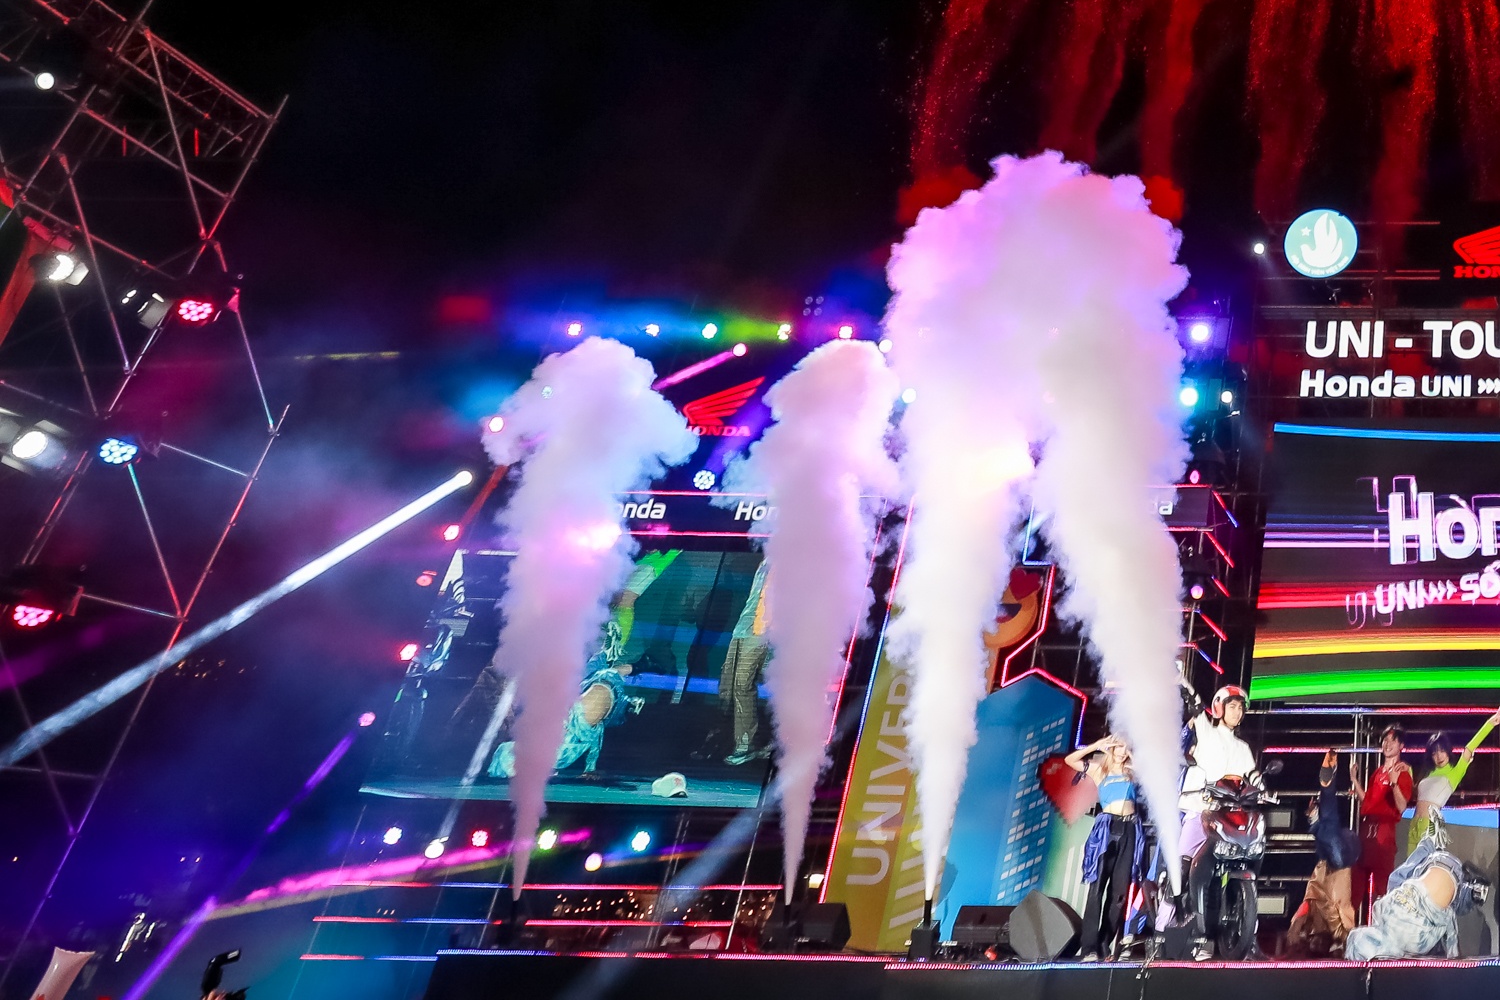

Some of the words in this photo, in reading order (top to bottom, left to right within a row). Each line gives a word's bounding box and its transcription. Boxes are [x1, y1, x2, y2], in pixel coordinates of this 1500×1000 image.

[1304, 320, 1384, 358] UNI
[1395, 337, 1413, 348] -
[1300, 369, 1415, 398] Honda
[1421, 375, 1471, 398] UNI
[1374, 579, 1425, 615] UNI
